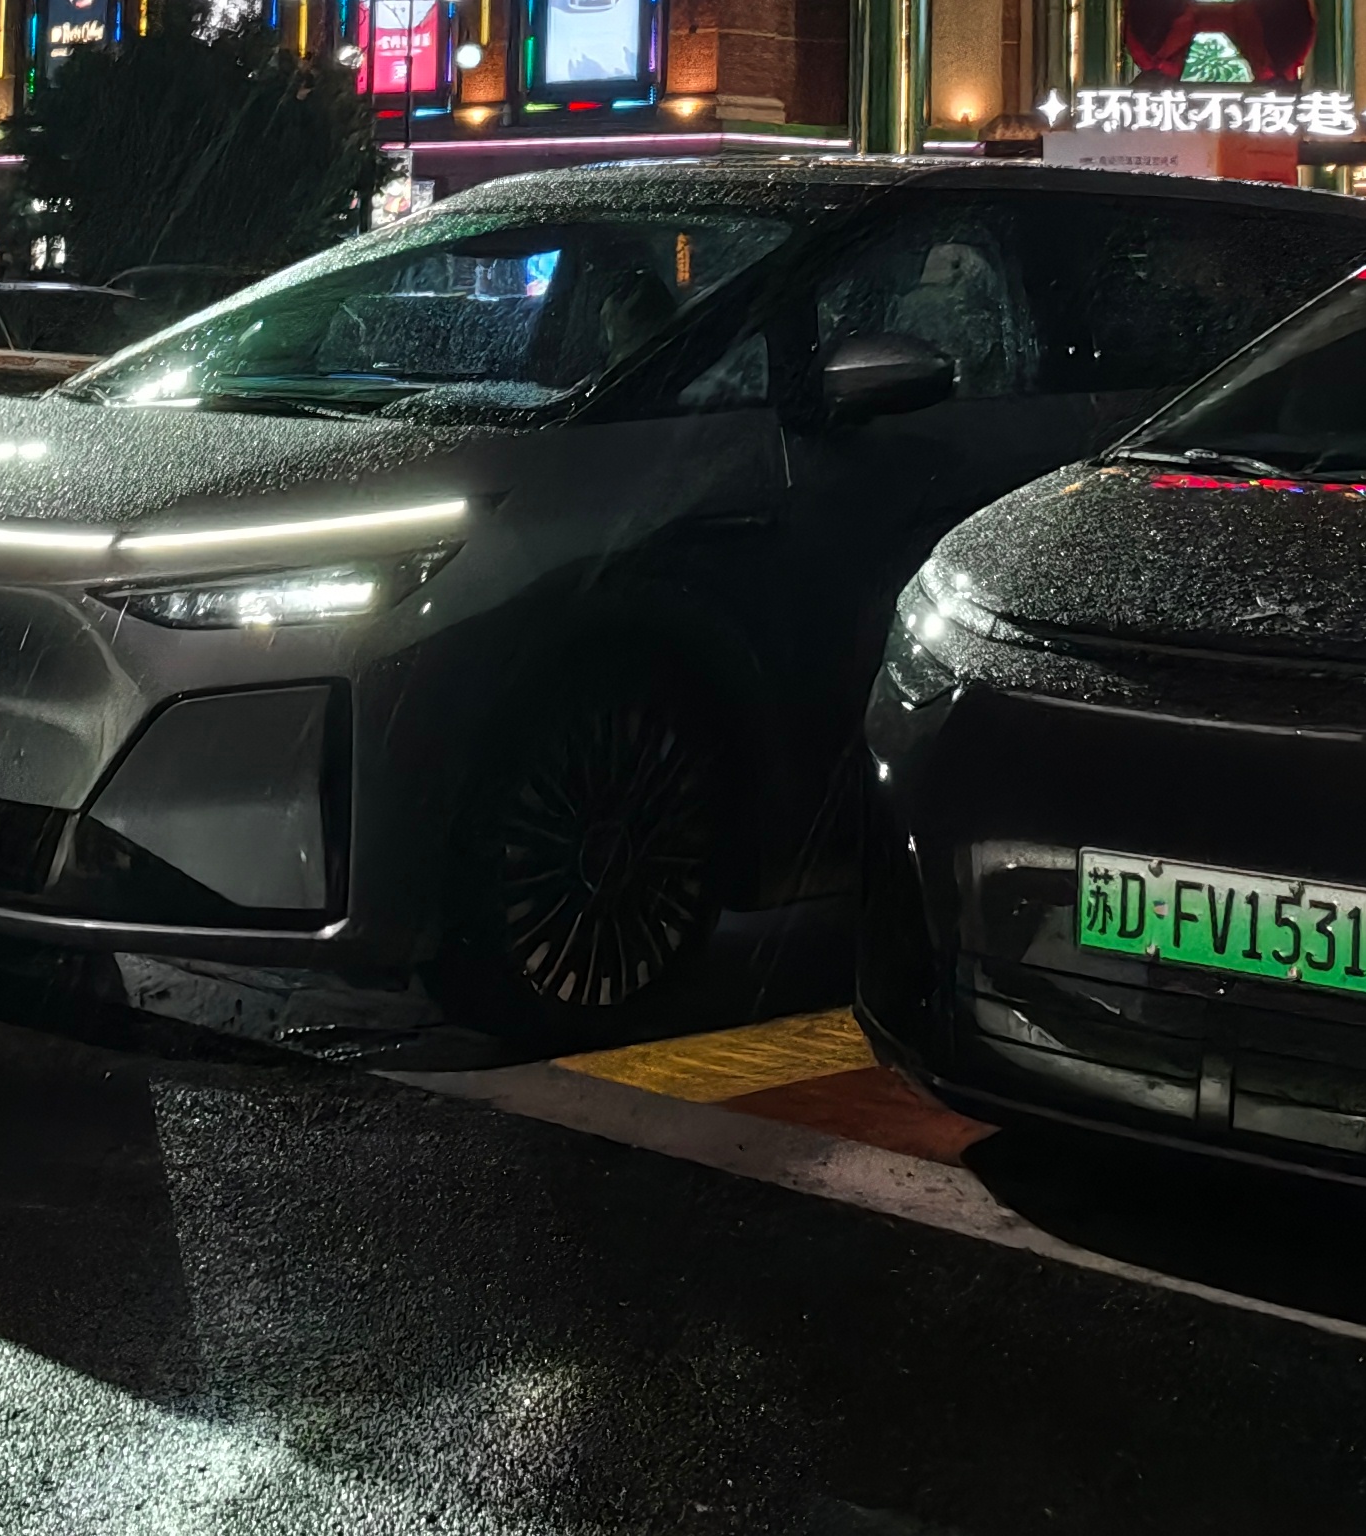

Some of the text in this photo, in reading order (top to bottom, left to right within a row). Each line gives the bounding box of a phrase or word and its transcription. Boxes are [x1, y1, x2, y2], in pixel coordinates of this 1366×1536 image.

[1075, 90, 1357, 135] 环球不夜巷
